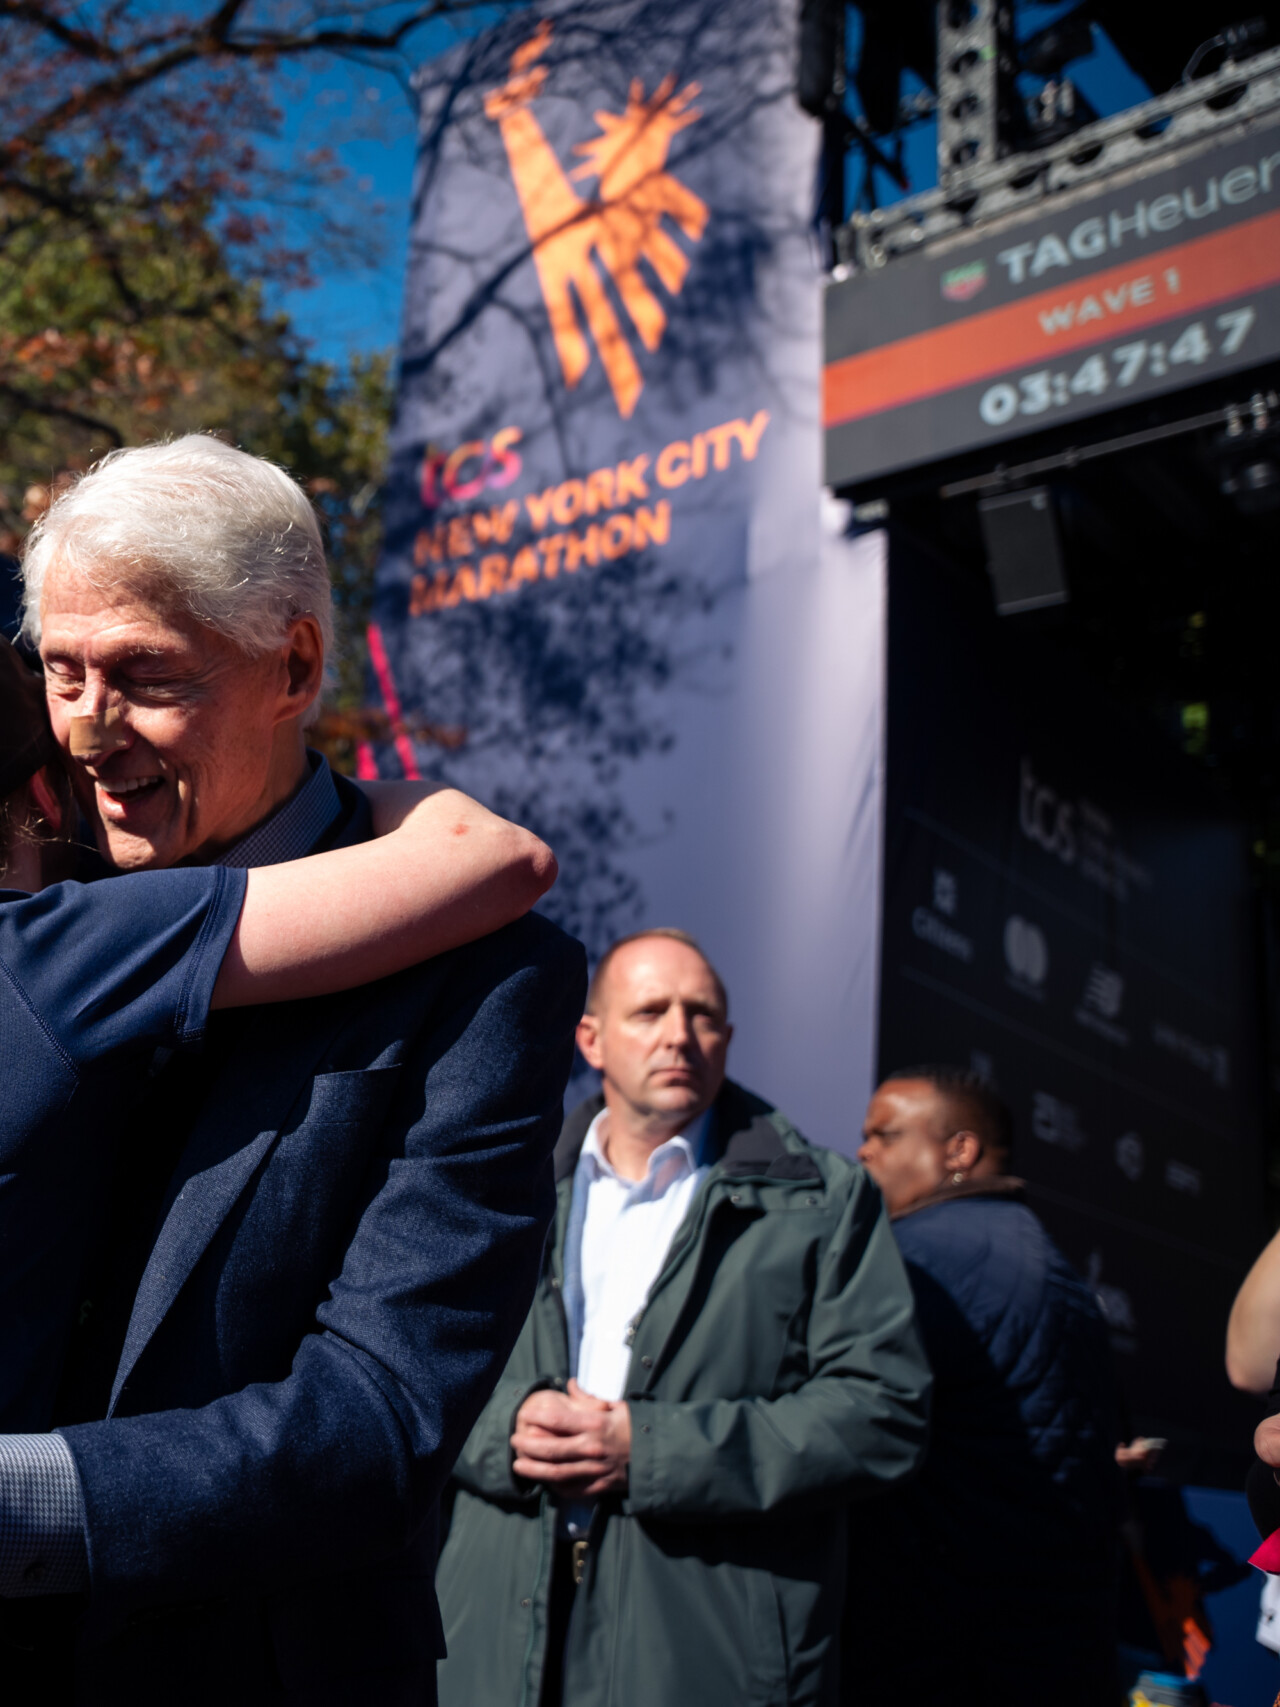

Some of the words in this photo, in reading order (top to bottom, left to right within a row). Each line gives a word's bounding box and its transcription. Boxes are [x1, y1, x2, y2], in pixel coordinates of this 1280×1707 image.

[1037, 275, 1155, 336] WAVE
[1163, 267, 1181, 294] 1
[980, 307, 1254, 426] 03:47:47
[414, 500, 518, 566] NEW
[525, 453, 650, 531] YORK
[655, 409, 770, 489] CITY
[409, 498, 671, 616] MARATHON
